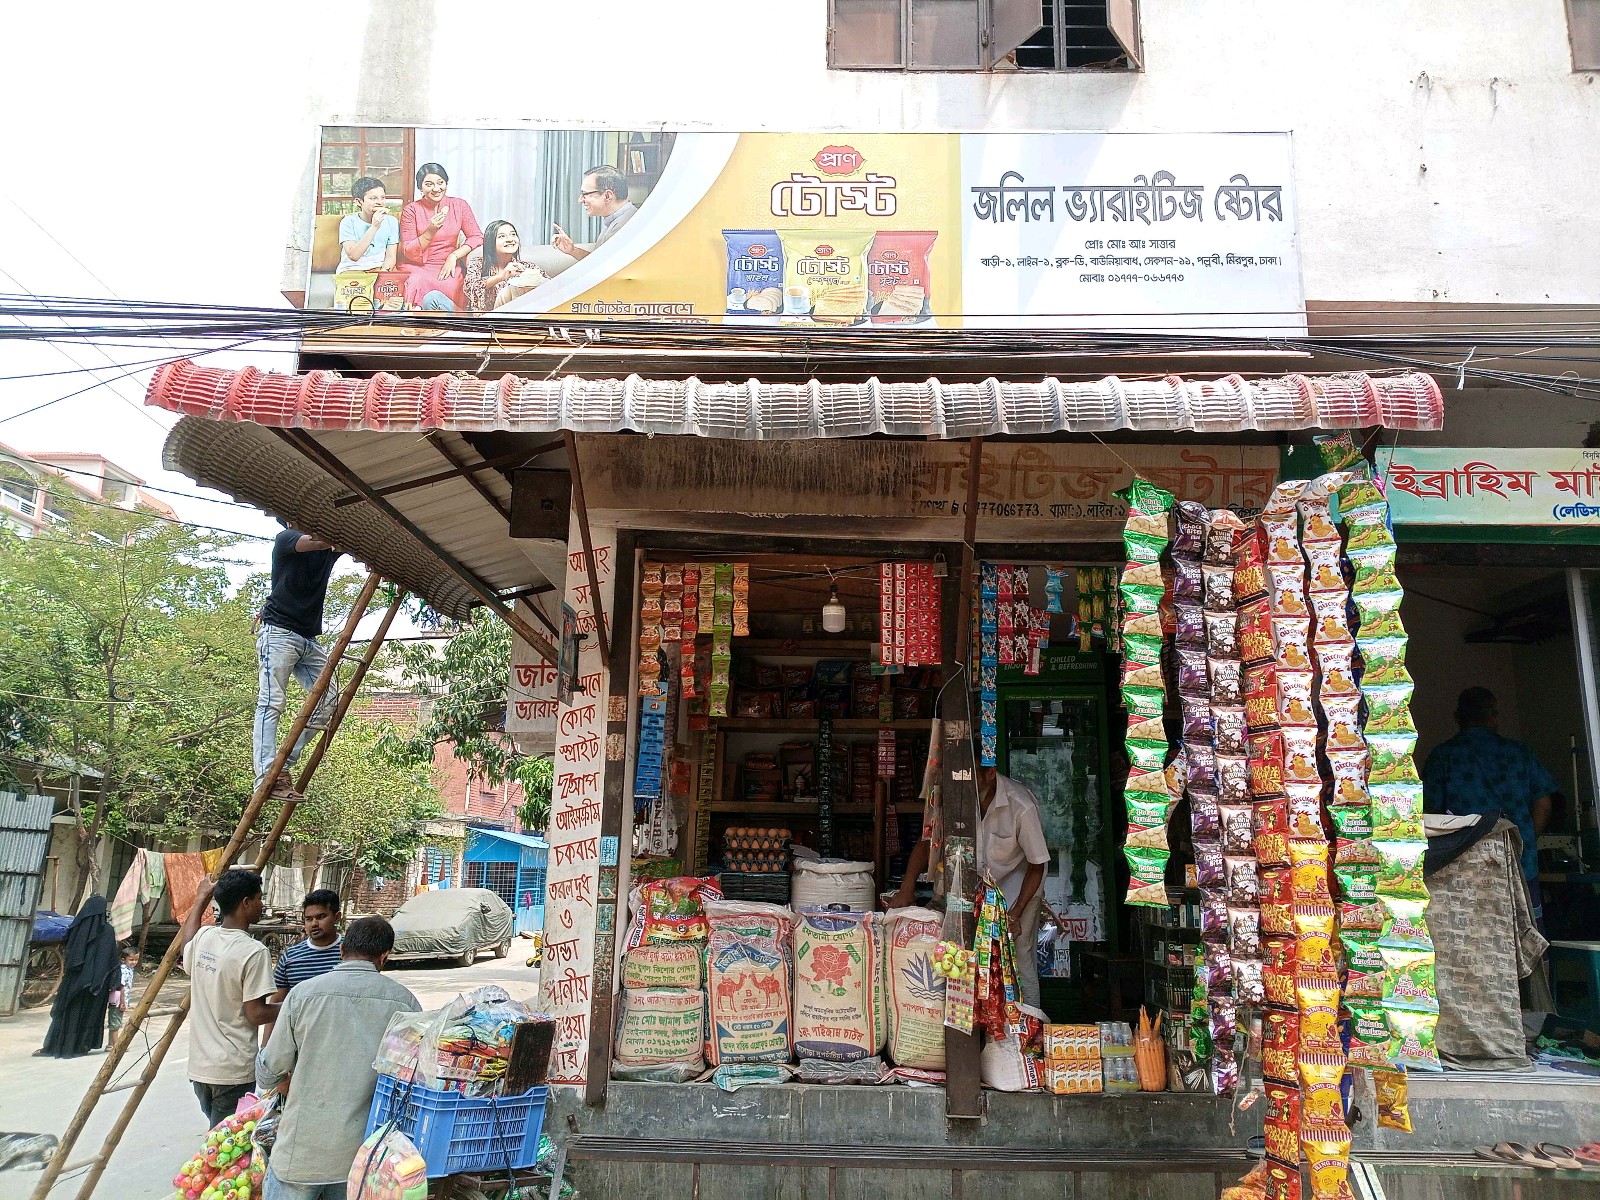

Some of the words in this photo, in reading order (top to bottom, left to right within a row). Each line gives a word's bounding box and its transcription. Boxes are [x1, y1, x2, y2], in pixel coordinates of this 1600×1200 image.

[818, 152, 857, 168] প্রাণ
[770, 172, 897, 217] টোস্ট
[971, 170, 1055, 223] জলিল
[1062, 169, 1204, 226] ভ্যারাইটিজ
[1106, 239, 1126, 250] মোঃ
[1128, 239, 1146, 250] আঃ
[1148, 239, 1176, 250] সাত্তার
[733, 256, 780, 272] টোস্ট
[796, 256, 850, 276] টোস্ট
[868, 260, 910, 276] টোস্ট
[1017, 255, 1054, 267] লাইন-১,
[1226, 252, 1258, 268] মিরপুর,
[571, 302, 591, 314] প্রাণ
[594, 300, 631, 314] টোস্টের
[1387, 461, 1538, 502] ইব্রাহিম
[560, 703, 596, 737] কোক
[559, 730, 601, 763] স্প্রাইট
[553, 836, 599, 868] চকবার
[559, 908, 574, 930] ও
[543, 967, 591, 1006] পানীয়
